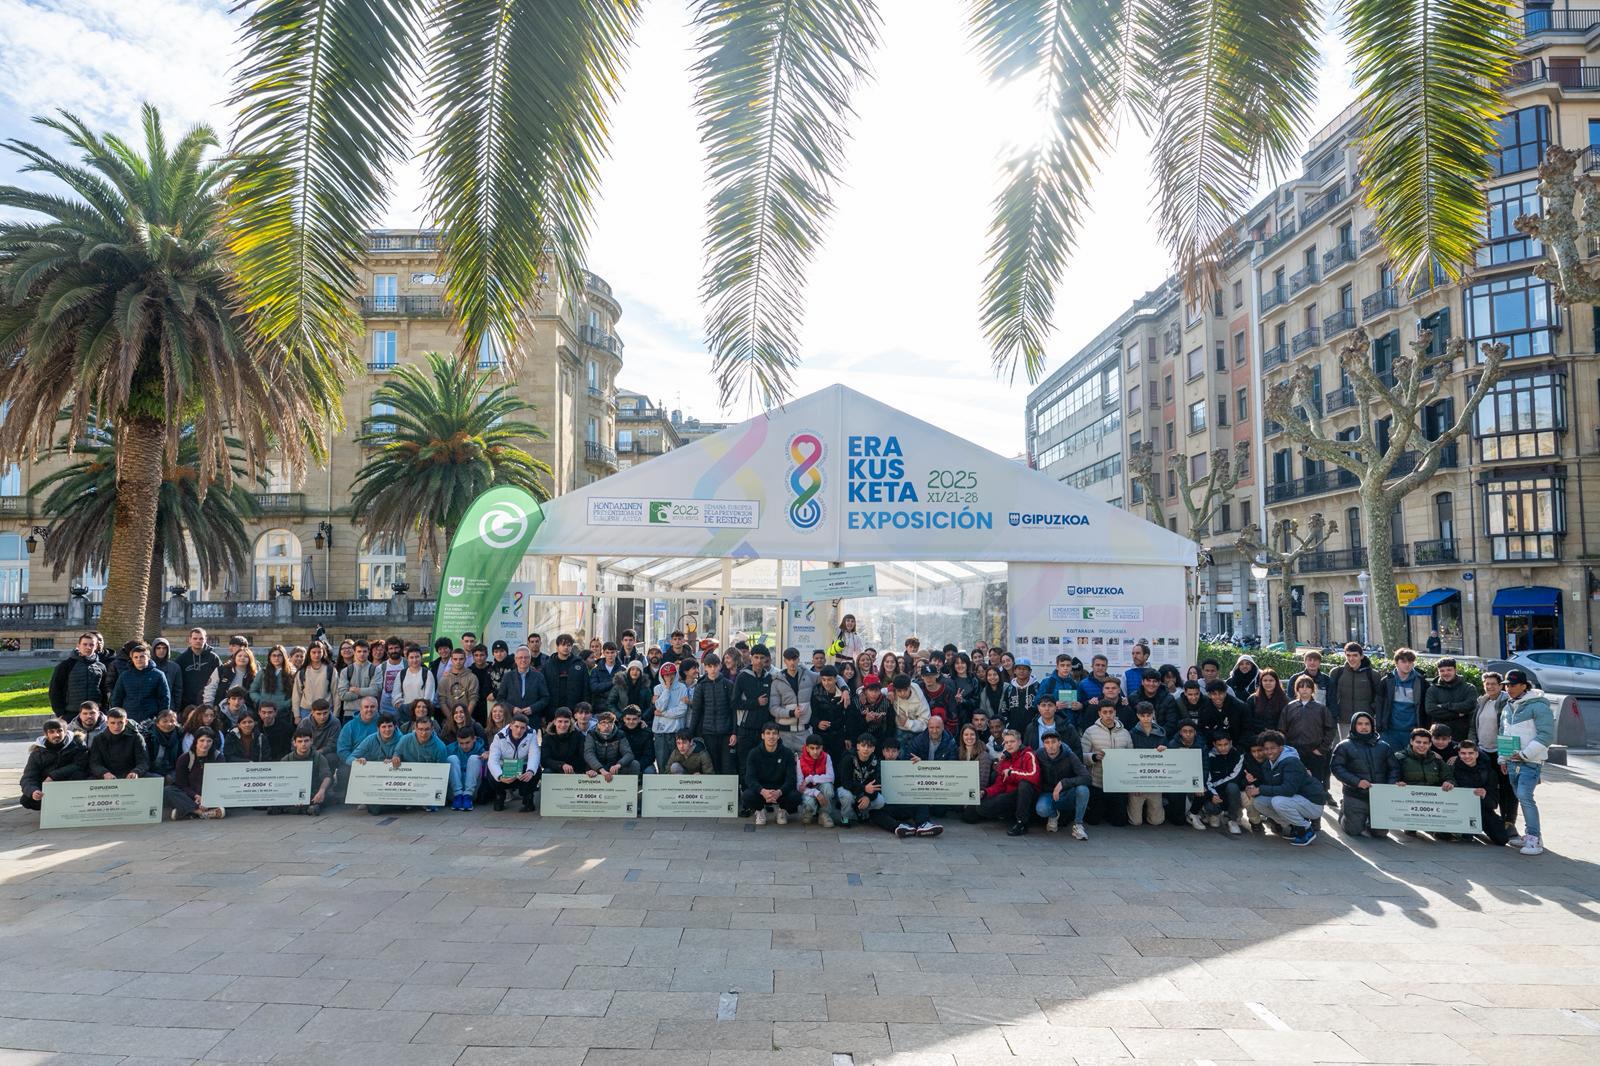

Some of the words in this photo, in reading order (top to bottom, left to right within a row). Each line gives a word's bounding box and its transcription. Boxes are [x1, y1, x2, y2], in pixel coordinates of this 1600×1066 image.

[848, 436, 903, 457] ERA
[848, 459, 905, 480] KUS
[927, 469, 978, 490] 2025
[848, 481, 919, 503] KETA
[927, 491, 979, 504] XI/21-28
[593, 502, 643, 510] HONDAKINEN
[672, 504, 700, 515] 2025
[716, 516, 752, 525] RESIDUOS
[848, 506, 993, 530] EXPOSICIÓN
[1022, 513, 1091, 526] GIPUZKOA
[1076, 586, 1124, 596] GIPUZKOA
